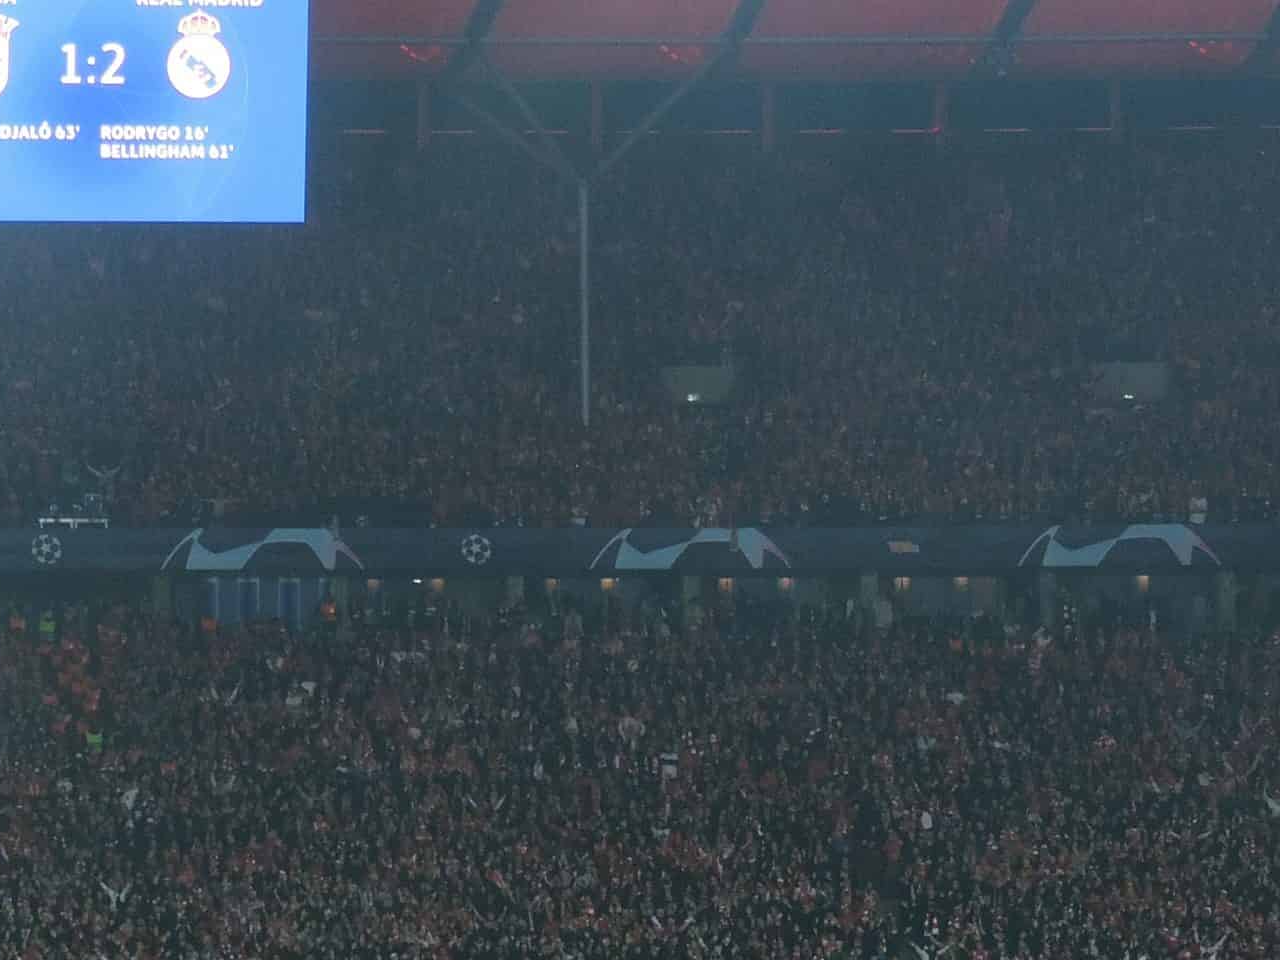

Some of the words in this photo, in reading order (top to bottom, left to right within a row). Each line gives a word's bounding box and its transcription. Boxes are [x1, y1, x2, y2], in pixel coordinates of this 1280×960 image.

[60, 43, 126, 84] 1:2
[0, 120, 51, 140] DJALÓ
[100, 125, 178, 141] RODRYGO
[100, 144, 204, 159] BELLINGHAM
